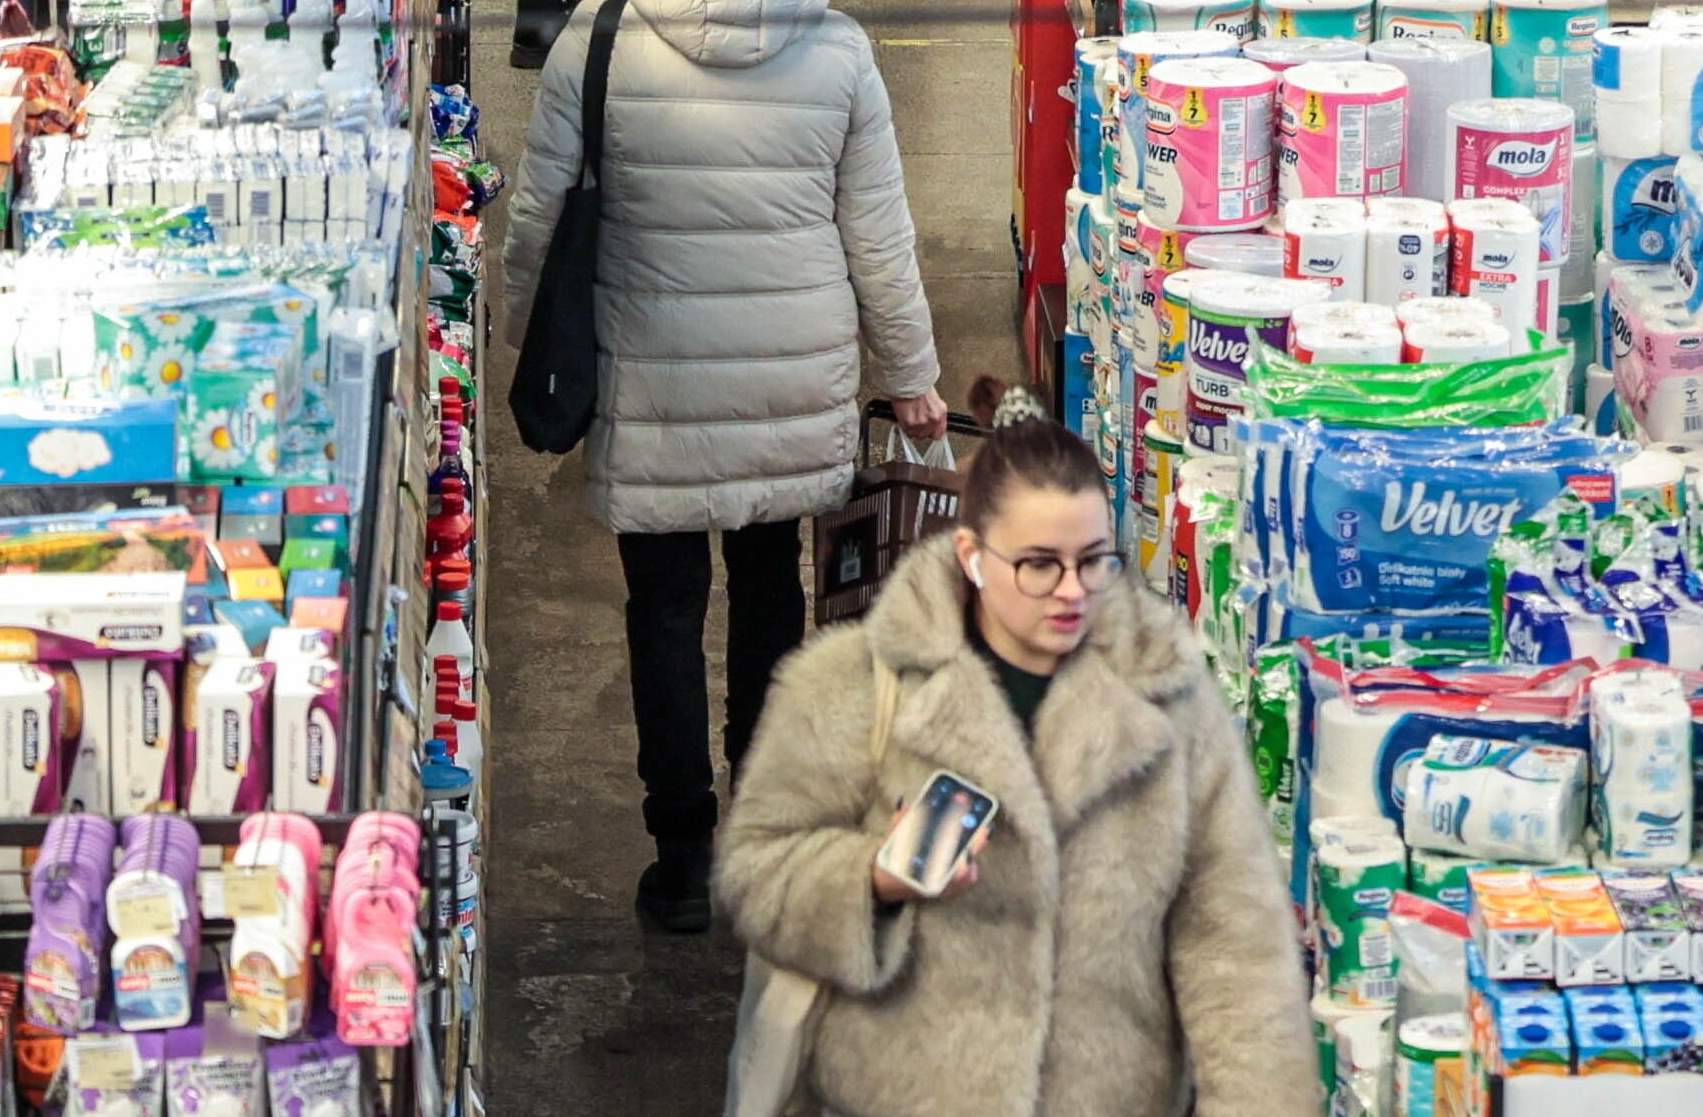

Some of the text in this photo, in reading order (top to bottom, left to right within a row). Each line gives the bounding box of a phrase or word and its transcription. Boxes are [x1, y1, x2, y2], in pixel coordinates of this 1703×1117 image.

[1498, 147, 1546, 165] mola
[1482, 252, 1508, 264] mola
[1479, 273, 1511, 283] EXTRA
[1190, 318, 1248, 362] Velve
[1195, 377, 1230, 397] TURB
[1381, 482, 1520, 536] Velvet
